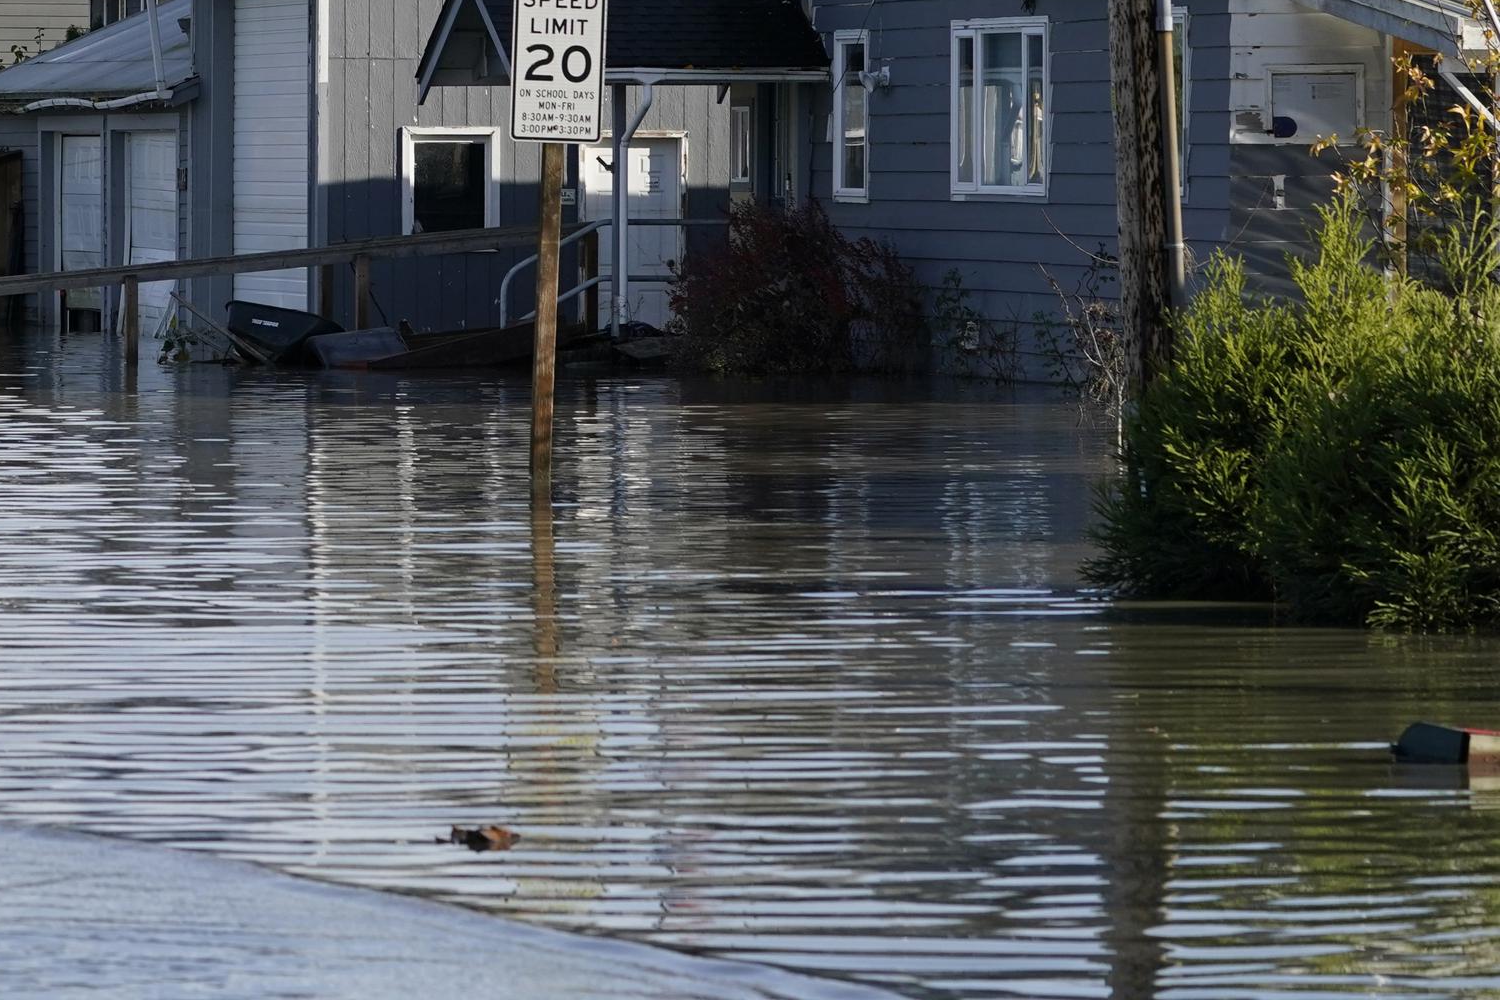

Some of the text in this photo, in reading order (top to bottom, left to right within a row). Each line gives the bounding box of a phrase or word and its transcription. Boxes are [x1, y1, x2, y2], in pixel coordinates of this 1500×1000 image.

[530, 18, 589, 36] LIMIT
[524, 43, 592, 83] 20
[519, 88, 595, 100] ON SCHOOL DAYS
[538, 101, 575, 111] MON-FRI
[521, 112, 591, 123] 8:30AM-9:30AM
[521, 124, 591, 135] 3:00PM3:30PM
